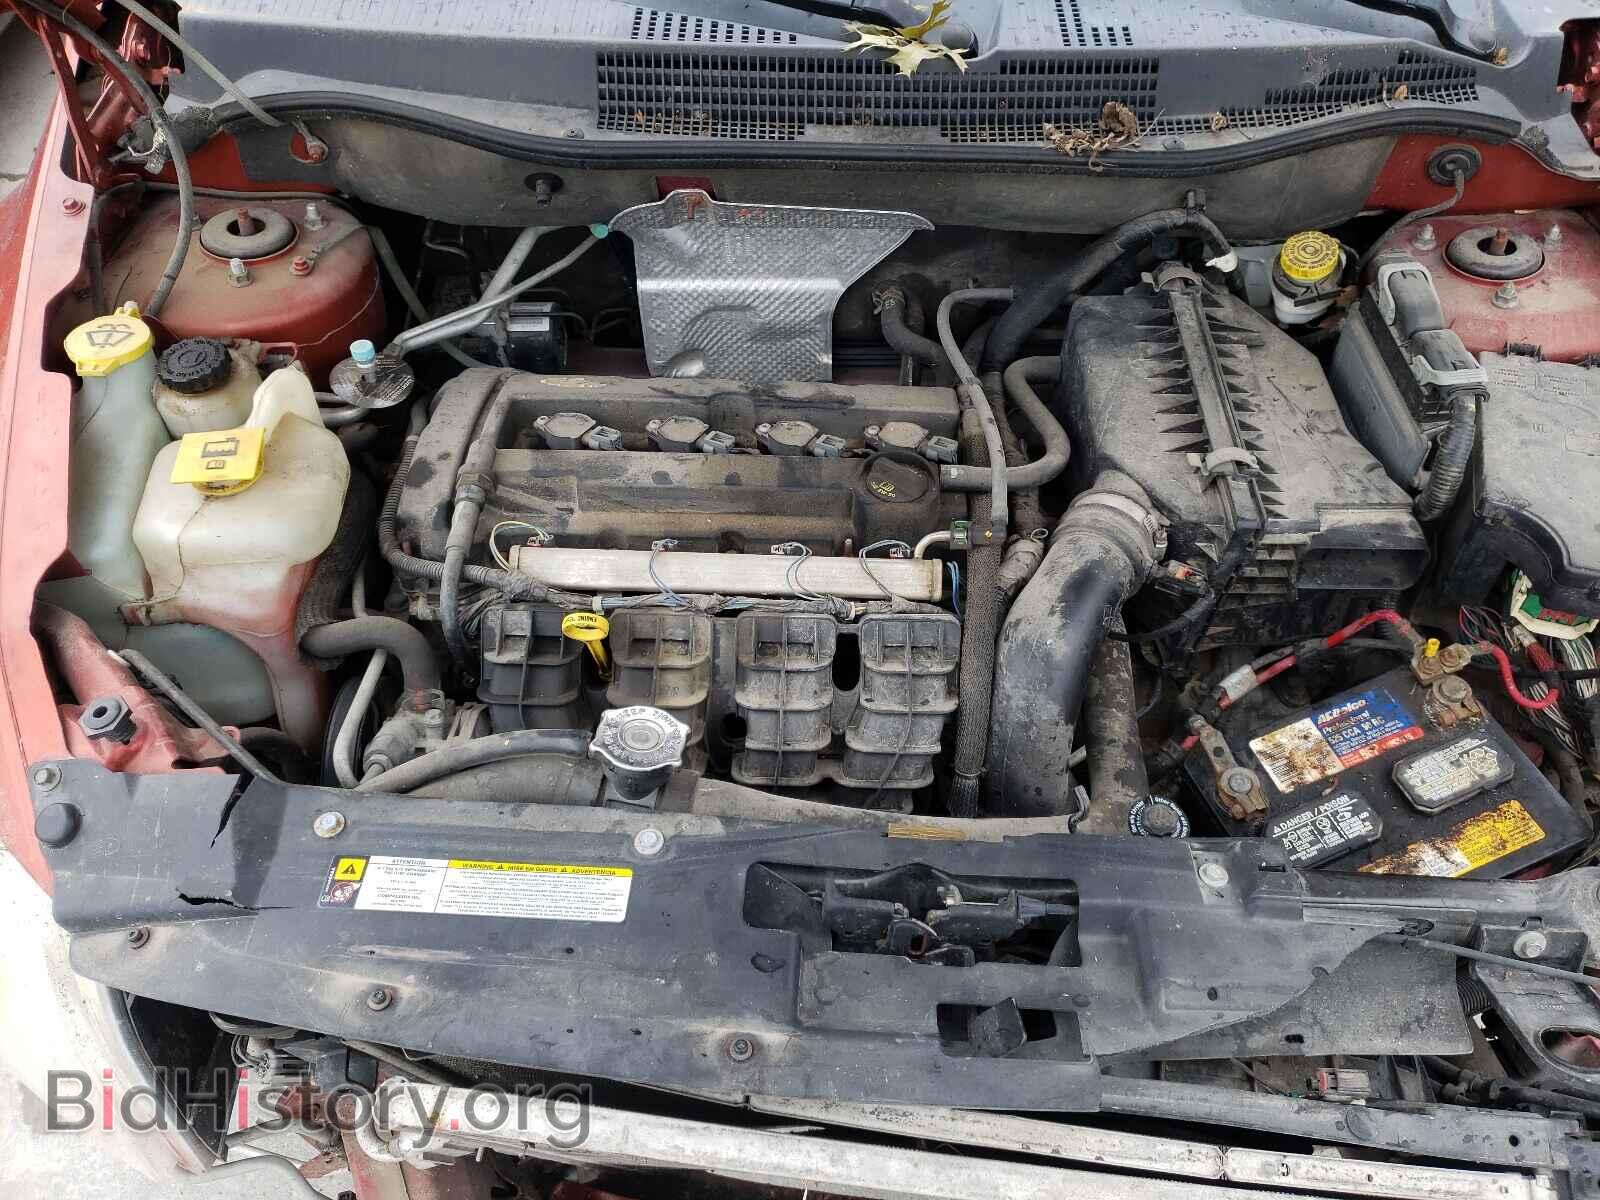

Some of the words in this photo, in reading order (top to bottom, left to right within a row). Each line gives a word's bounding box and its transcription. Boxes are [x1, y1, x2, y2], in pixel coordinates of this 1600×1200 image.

[1343, 726, 1361, 739] CCA
[1280, 811, 1314, 830] DANGER
[1319, 794, 1350, 813] POISON
